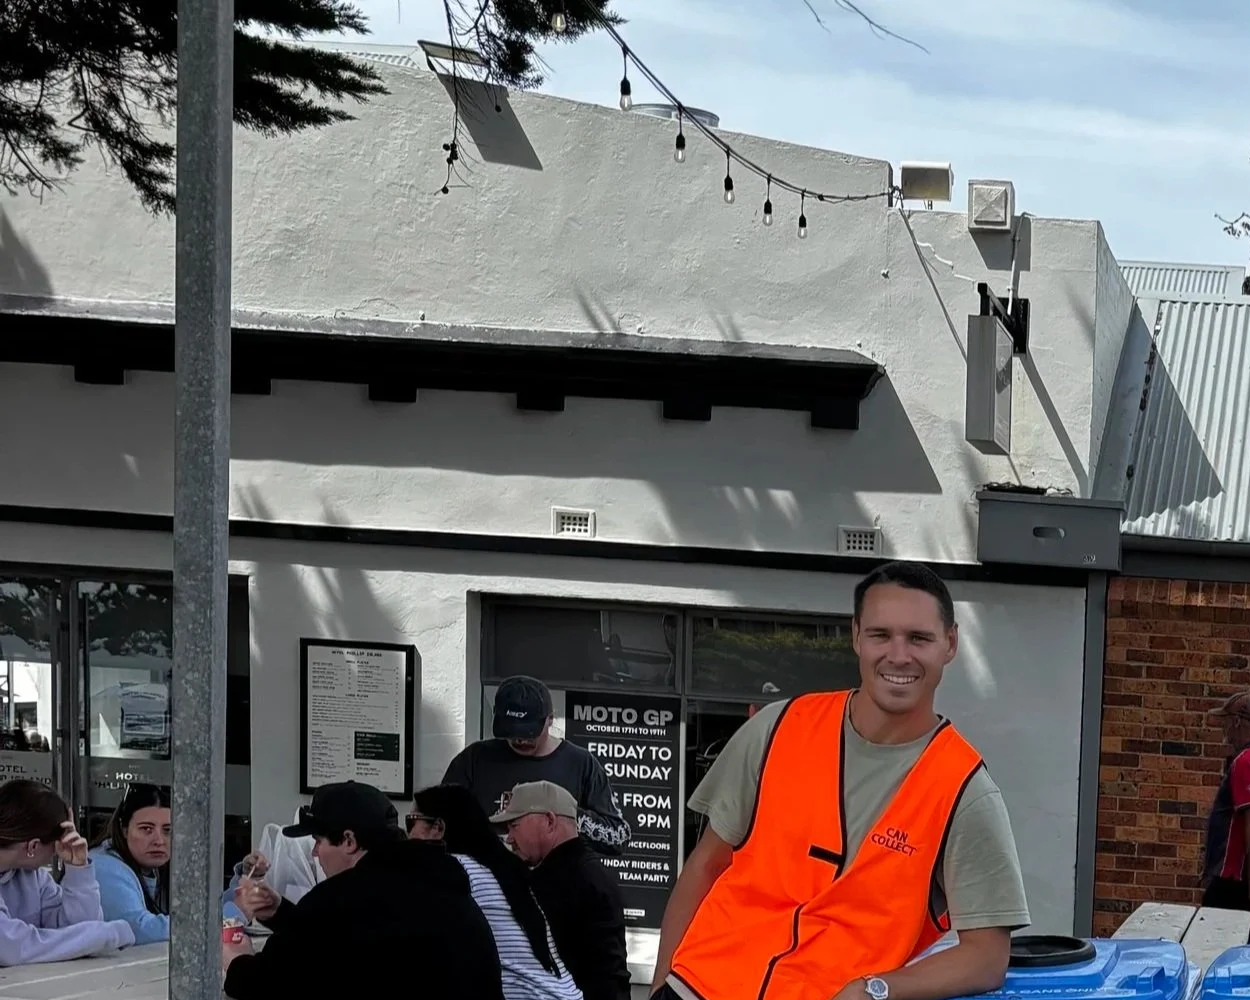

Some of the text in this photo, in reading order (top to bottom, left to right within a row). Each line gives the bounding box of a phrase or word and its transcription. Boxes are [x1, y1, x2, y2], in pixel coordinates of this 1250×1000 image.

[573, 704, 674, 726] MOTO GP
[586, 724, 620, 733] OCTOBER
[621, 727, 638, 735] 17TH
[649, 728, 666, 736] 19TH
[649, 746, 672, 761] TO
[604, 763, 672, 781] SUNDAY
[623, 792, 672, 810] FROM
[637, 813, 671, 829] 9PM
[886, 828, 908, 843] CAN
[871, 833, 917, 857] COLLECT
[631, 860, 662, 871] RIDERS
[663, 863, 670, 871] &
[619, 872, 670, 883] TEAM PARTY
